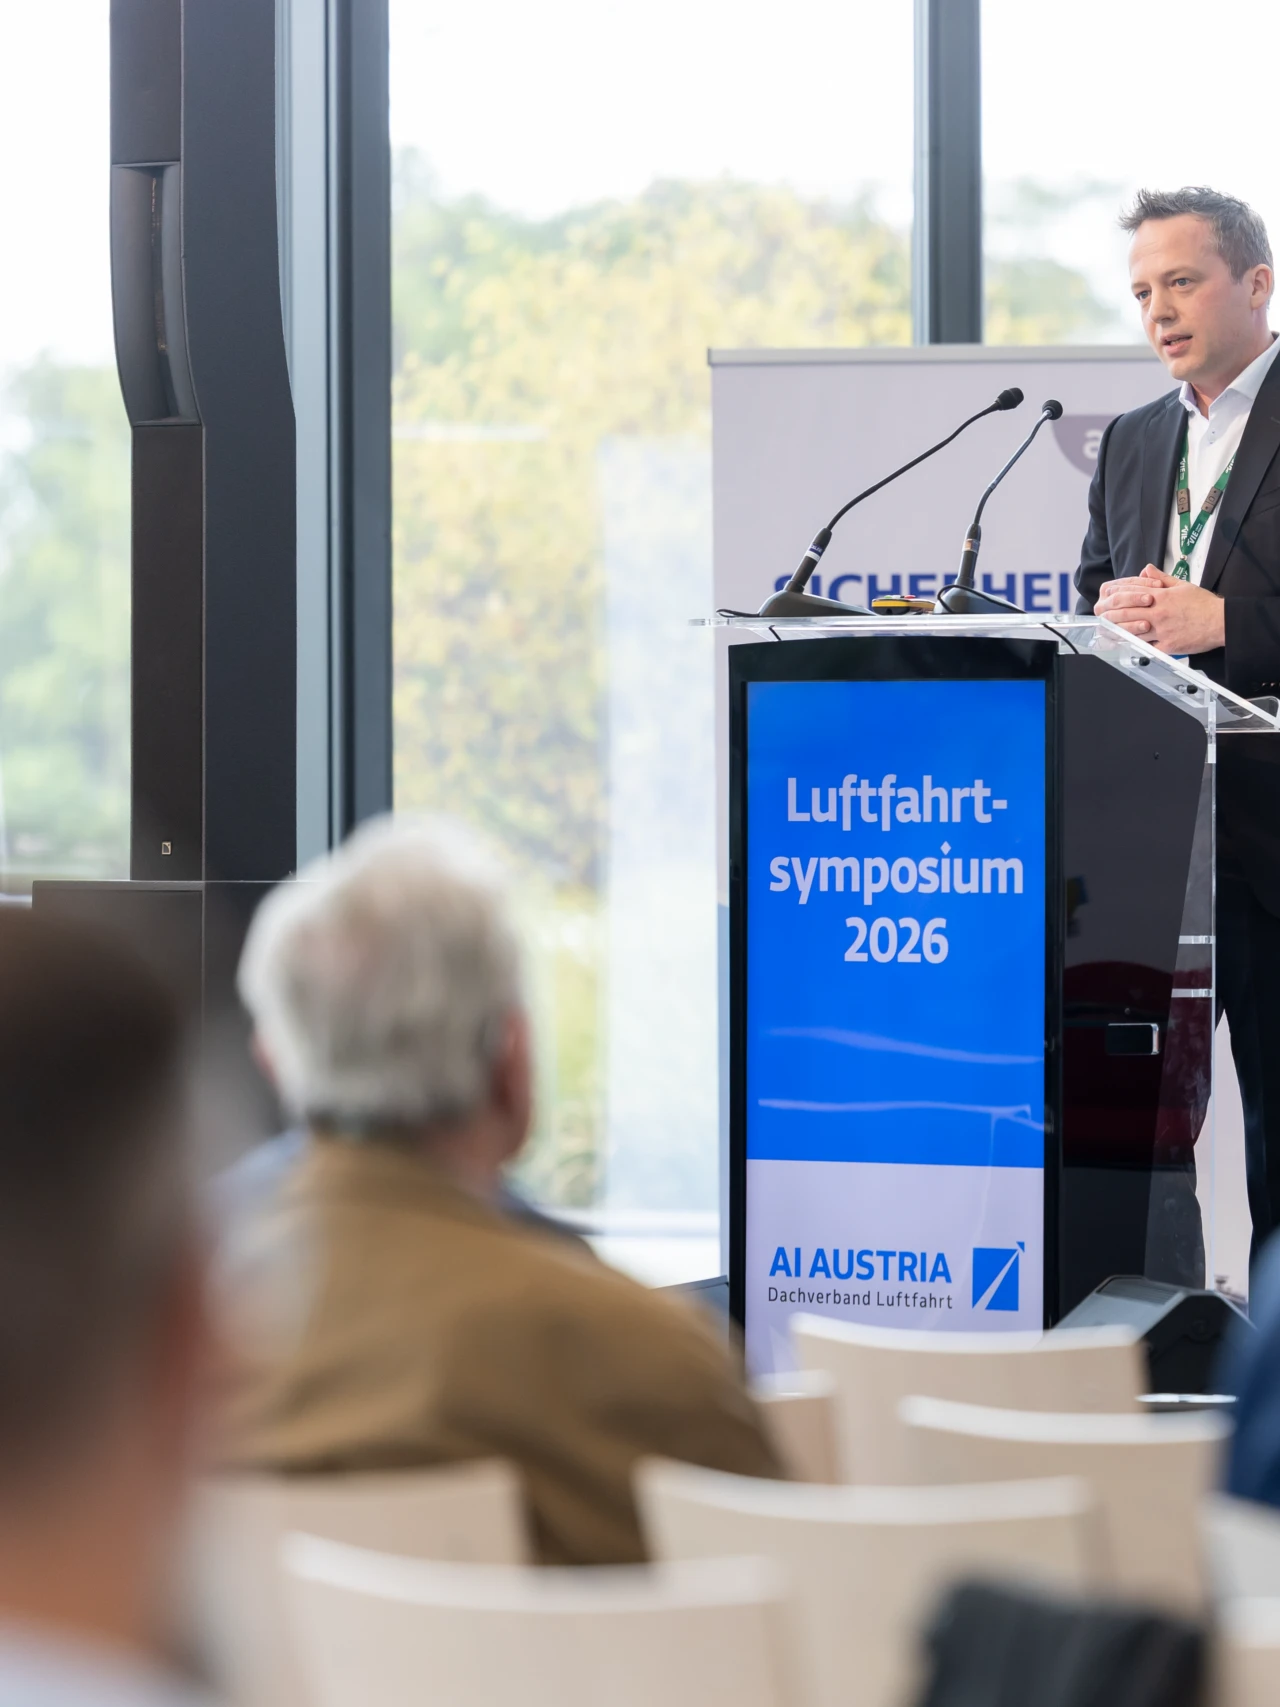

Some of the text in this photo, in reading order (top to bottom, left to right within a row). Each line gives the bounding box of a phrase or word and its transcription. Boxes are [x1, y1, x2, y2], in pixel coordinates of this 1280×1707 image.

[787, 774, 1008, 831] Luftfahrt-
[769, 841, 1024, 905] symposium
[844, 916, 949, 965] 2026
[769, 1246, 952, 1284] AI AUSTRIA
[768, 1286, 953, 1310] Dachverband Luftfahrt
